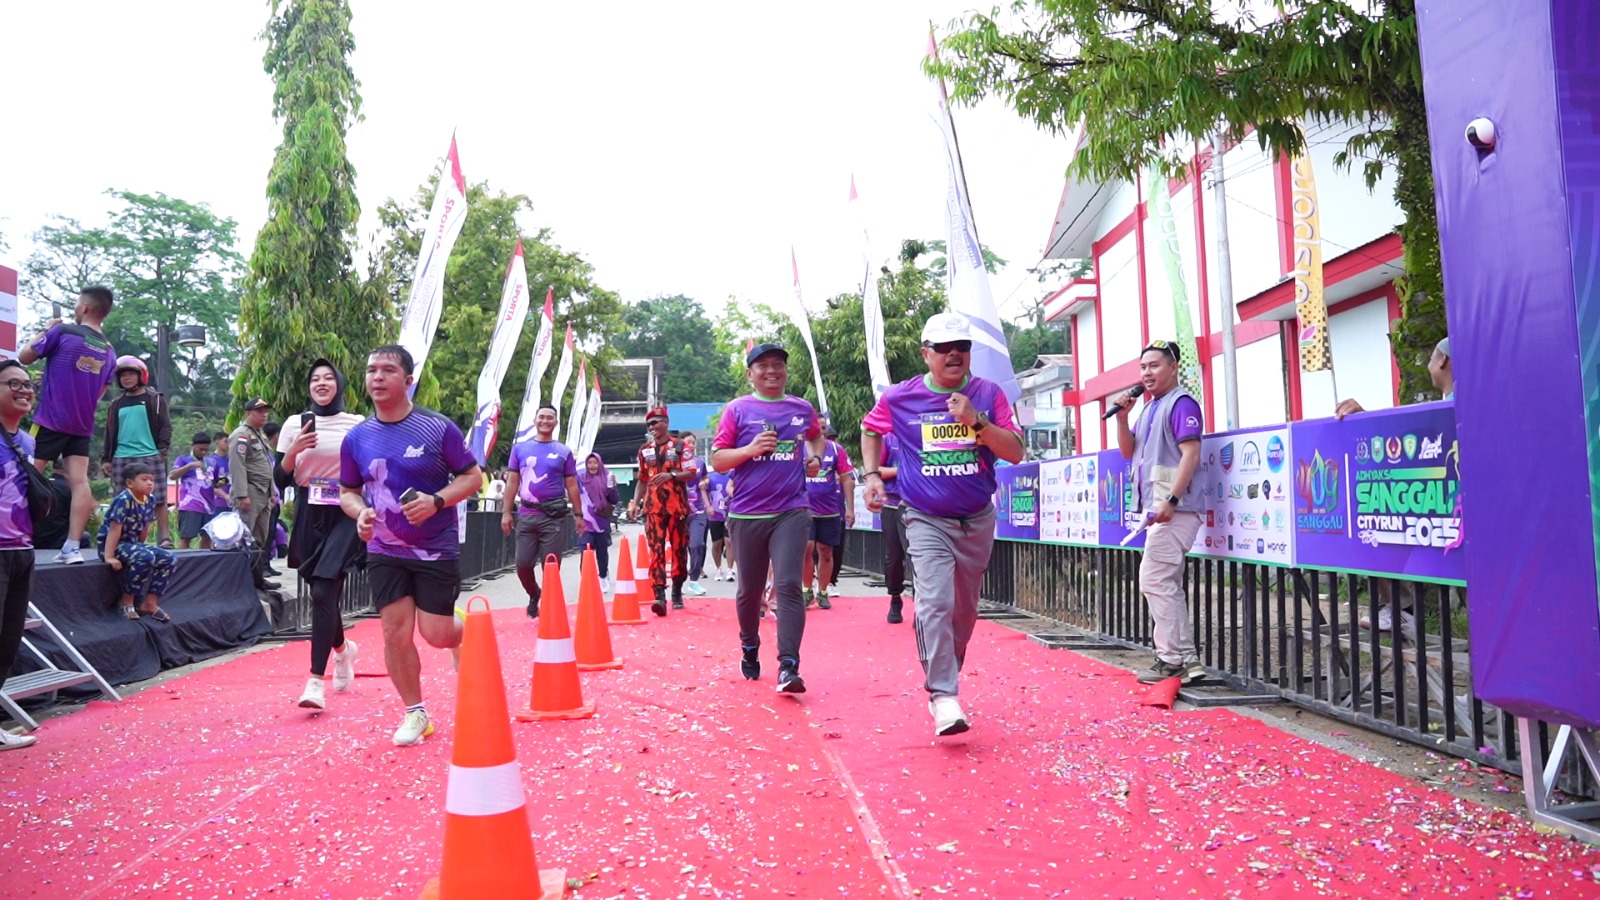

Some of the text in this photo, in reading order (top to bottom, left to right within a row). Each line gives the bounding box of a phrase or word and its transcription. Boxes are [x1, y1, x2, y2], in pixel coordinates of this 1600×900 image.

[505, 283, 523, 321] SPORTA
[932, 424, 968, 439] 00020
[921, 463, 978, 476] CITYRUN
[1297, 515, 1343, 529] SANGGAU
[1357, 515, 1403, 531] CITYRUN
[1405, 516, 1461, 548] 2025
